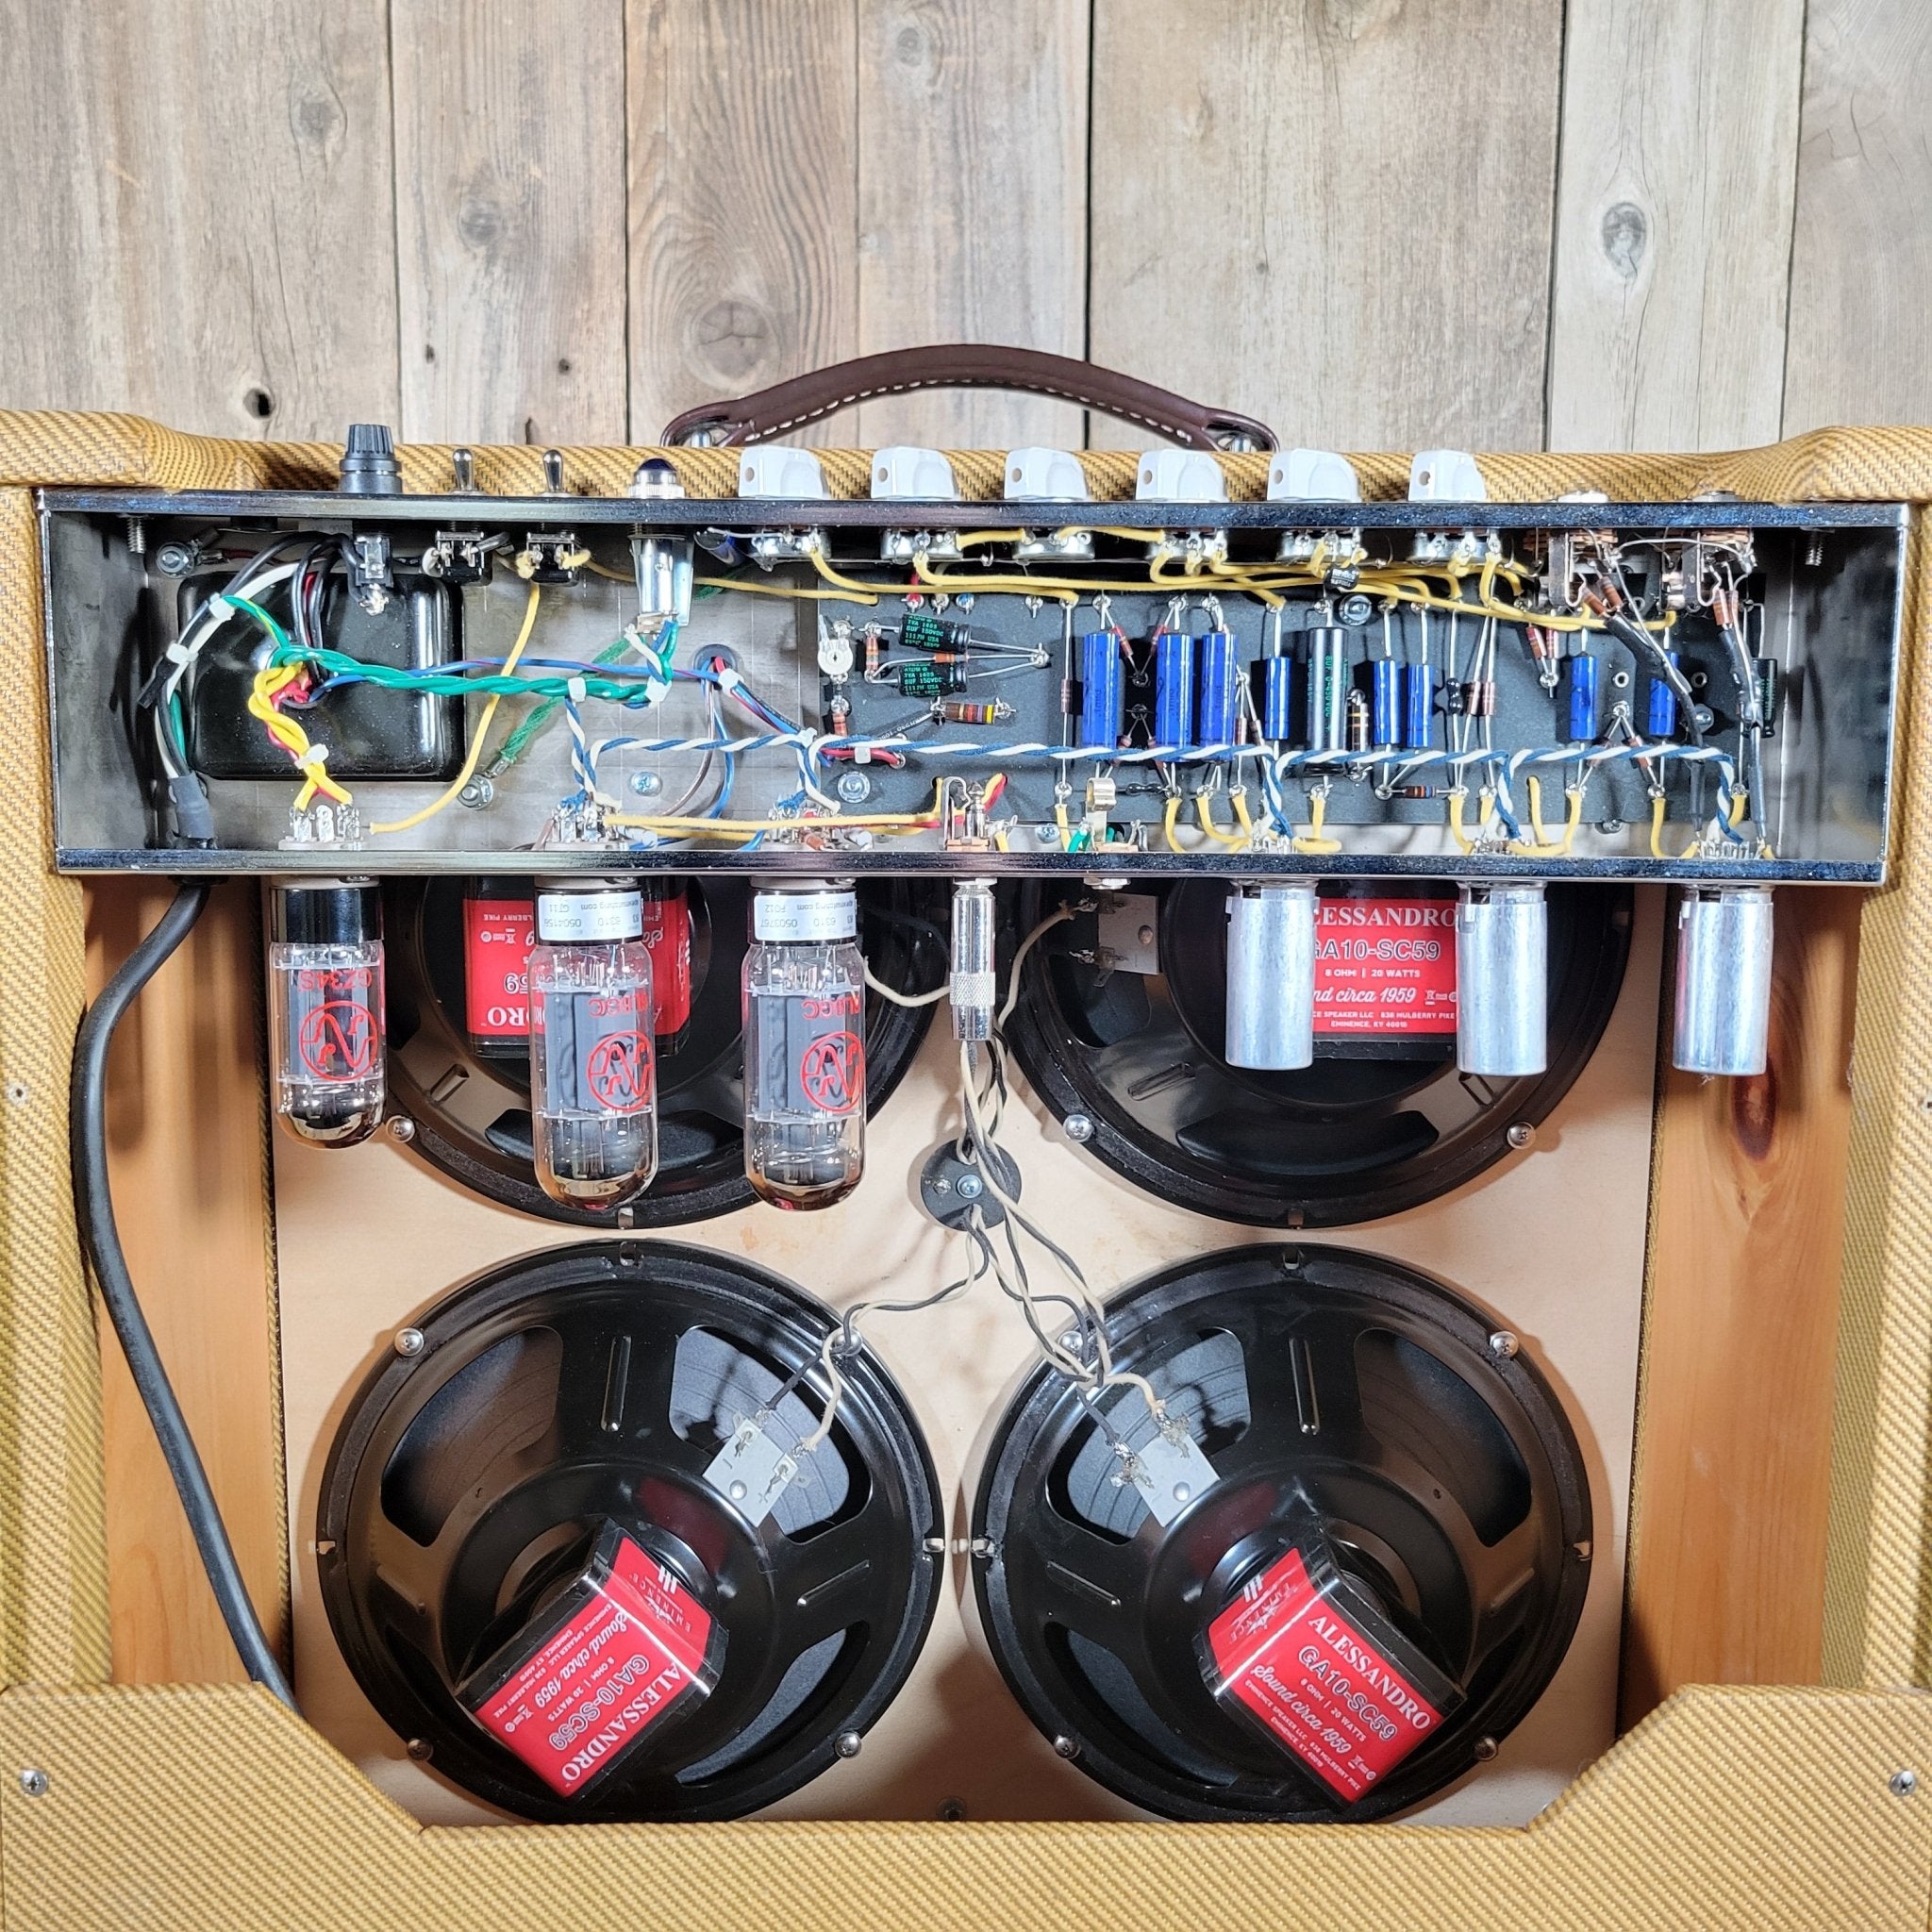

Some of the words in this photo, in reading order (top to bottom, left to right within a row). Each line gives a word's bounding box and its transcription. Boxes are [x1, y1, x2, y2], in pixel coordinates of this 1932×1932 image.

[1336, 989, 1376, 1002] circa
[1380, 987, 1417, 1004] 1959
[533, 1675, 562, 1707] 1959
[558, 1647, 591, 1681] circa
[591, 1662, 608, 1680] OHM
[1297, 1644, 1398, 1740] GA10-SC59
[1308, 1615, 1430, 1730] ALESSANDRO
[547, 1695, 574, 1722] WATTS
[548, 1652, 651, 1752] GA10-SC59
[560, 1662, 682, 1782] ALESSANDRO
[1249, 1662, 1298, 1704] Sound
[1291, 1699, 1324, 1730] circa
[1320, 1726, 1352, 1755] 1959
[1306, 1684, 1324, 1702] OHM
[1330, 1707, 1342, 1719] 20
[1340, 1716, 1366, 1742] WATTS
